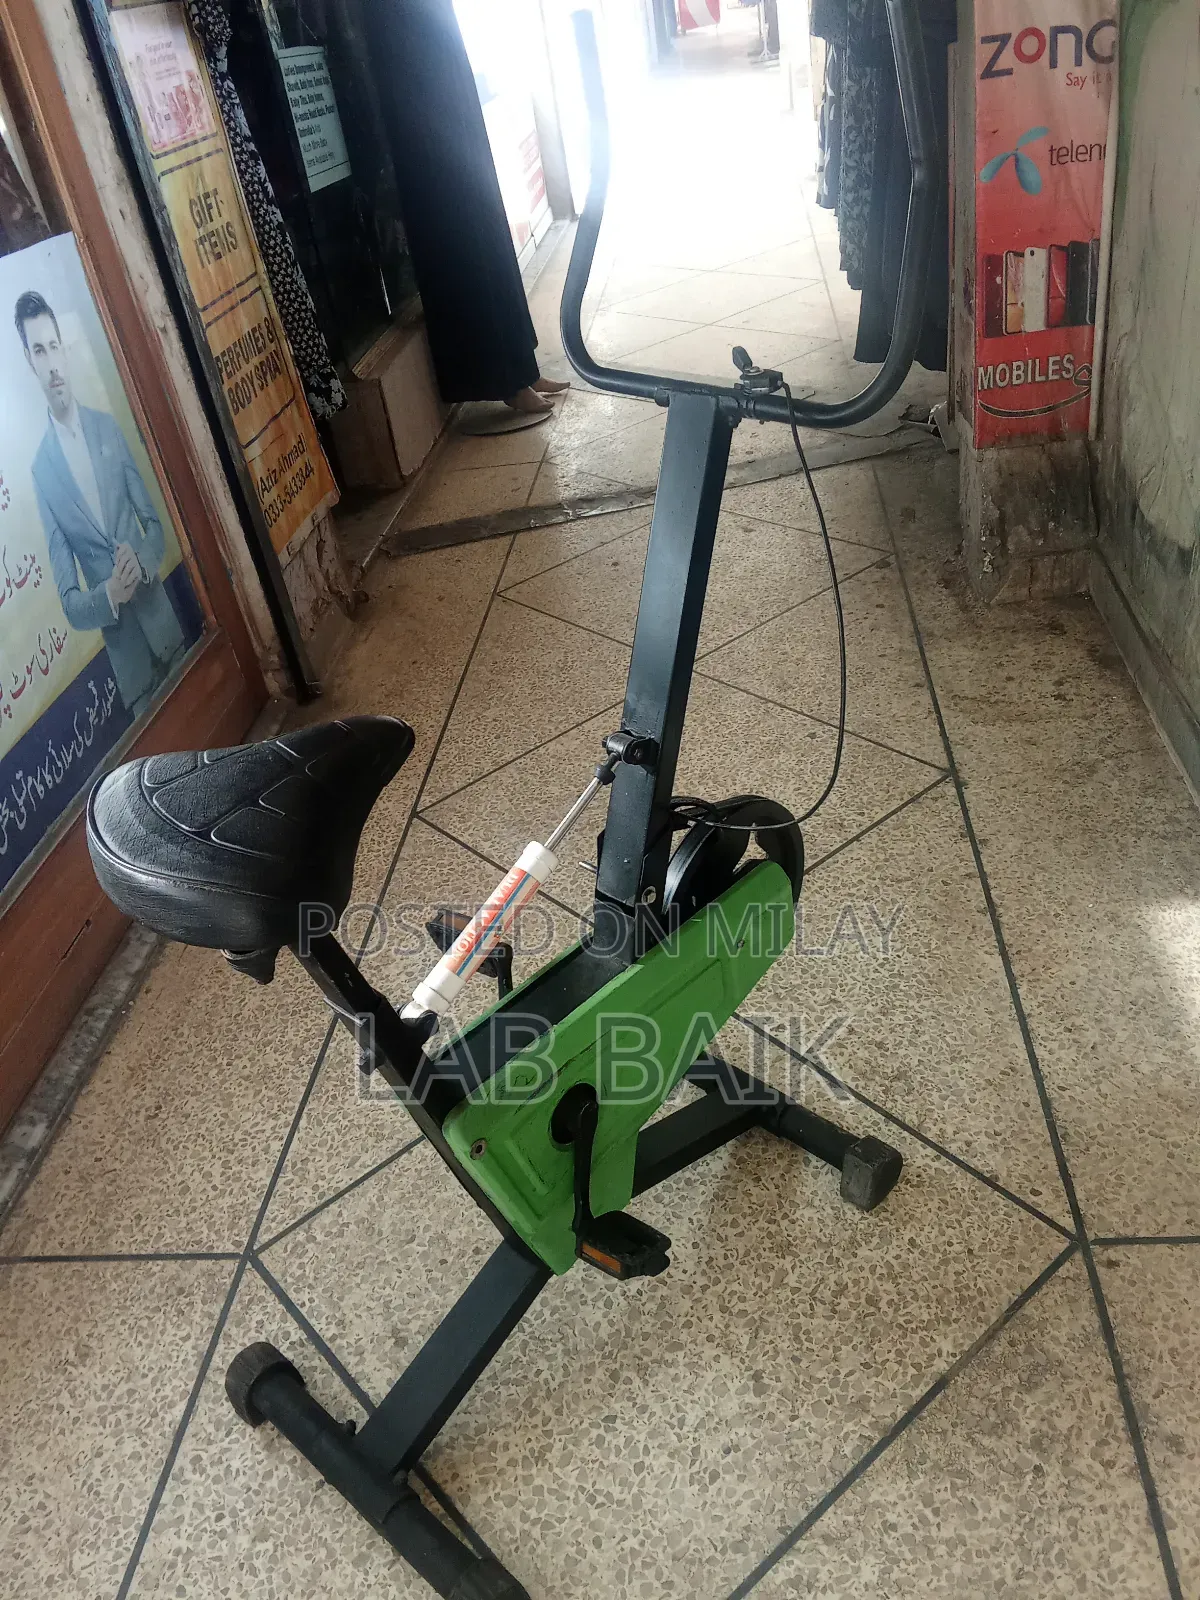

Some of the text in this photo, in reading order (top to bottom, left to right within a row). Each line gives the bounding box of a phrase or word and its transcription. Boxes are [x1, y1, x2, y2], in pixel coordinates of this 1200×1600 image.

[1065, 72, 1088, 91] Say
[1048, 139, 1107, 166] telen
[188, 187, 223, 229] GIFT
[194, 221, 238, 269] ITEMS
[214, 322, 267, 385] PERFUMES
[977, 353, 1075, 391] MOBILES
[227, 369, 258, 416] BODY
